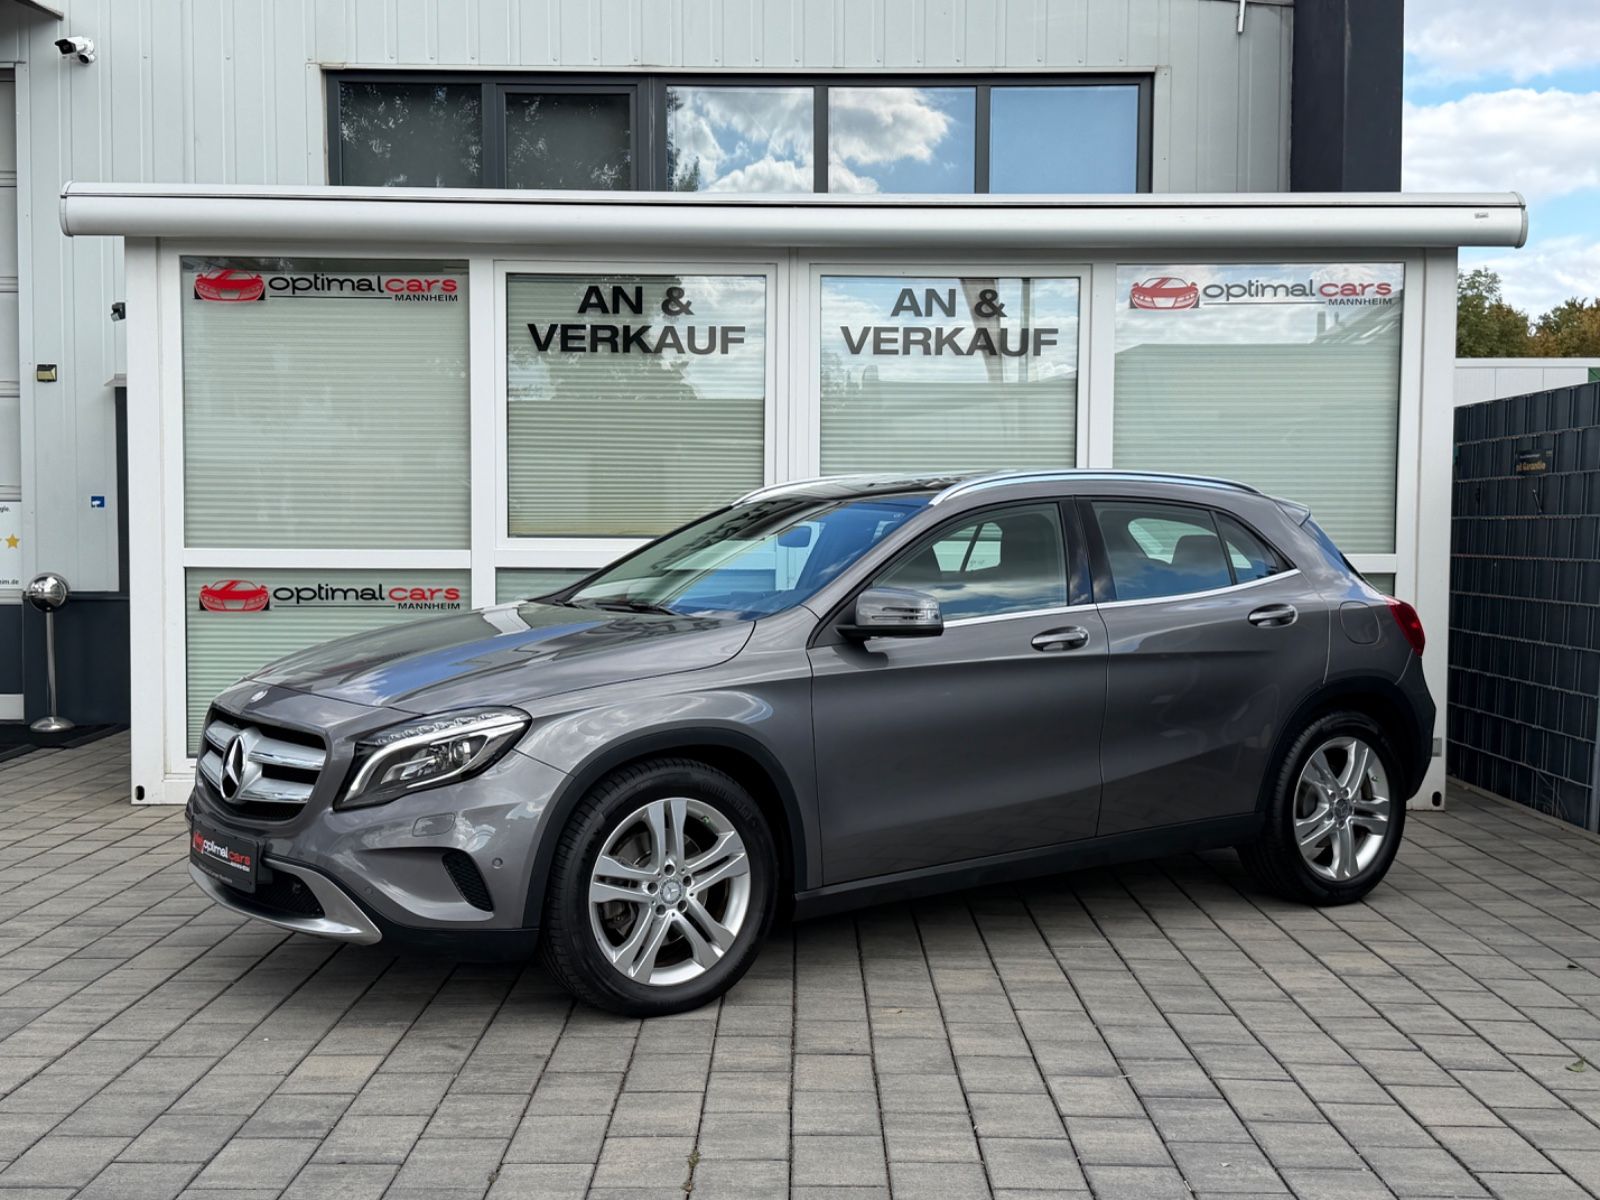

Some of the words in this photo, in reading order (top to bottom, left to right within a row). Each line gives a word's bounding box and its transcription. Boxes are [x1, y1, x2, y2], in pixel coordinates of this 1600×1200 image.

[394, 294, 459, 302] MANNHEIM
[577, 285, 643, 315] AN
[661, 286, 695, 316] &
[890, 287, 957, 318] AN
[974, 288, 1008, 318] &
[1328, 297, 1393, 306] MANNHEIM
[527, 323, 746, 356] VERKAUF
[840, 325, 1059, 357] VERKAUF
[397, 602, 461, 610] MANNHEIM
